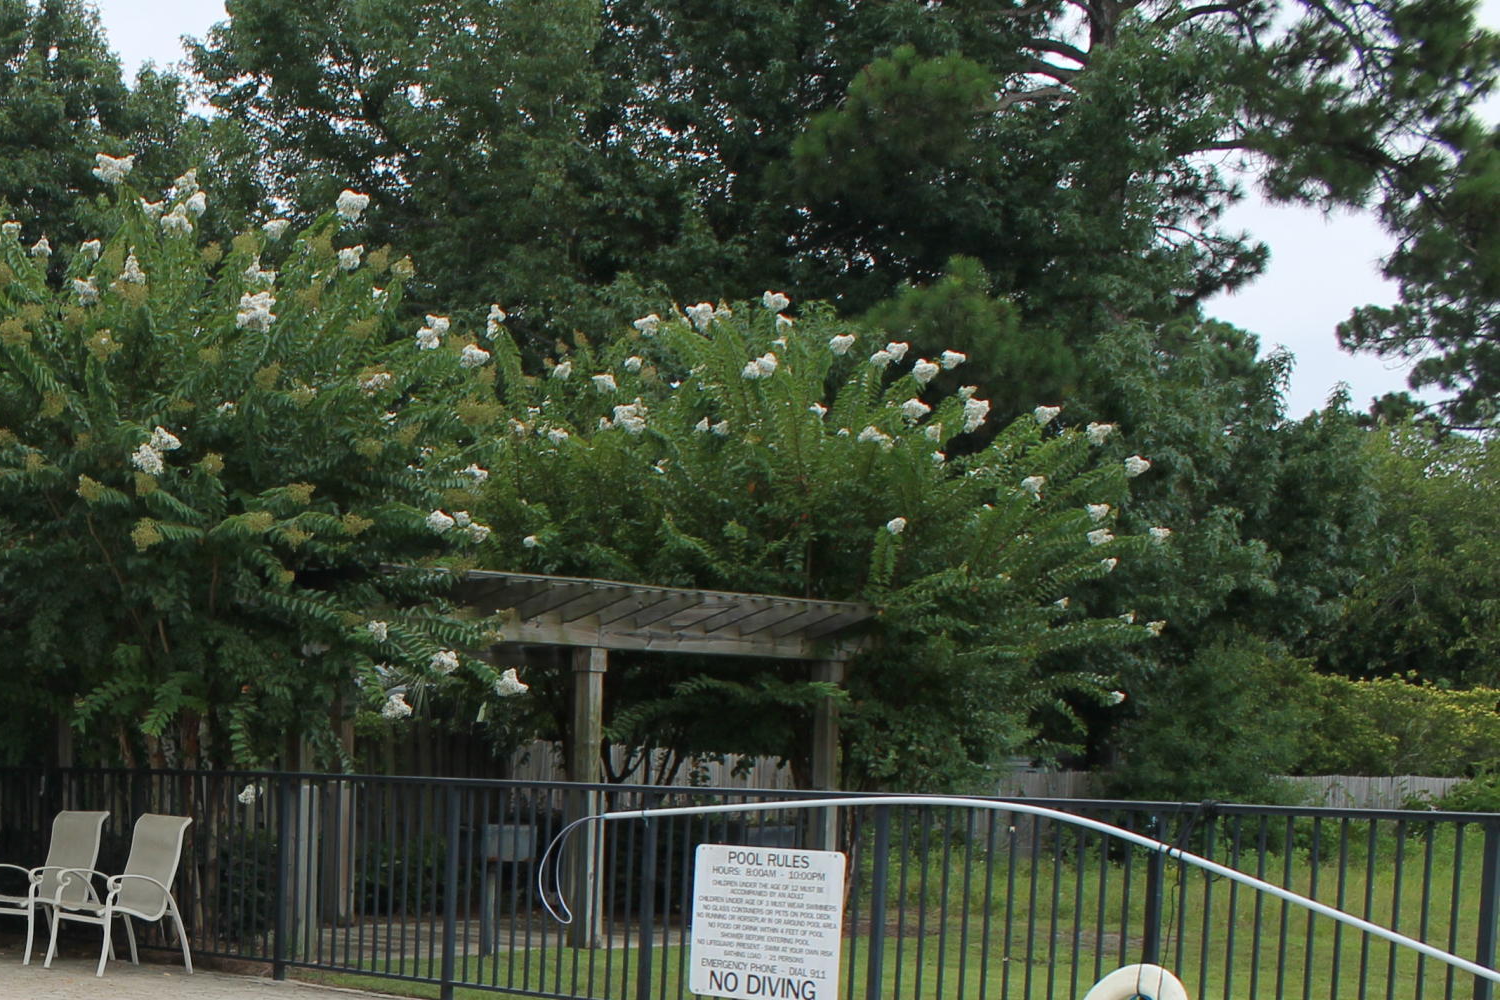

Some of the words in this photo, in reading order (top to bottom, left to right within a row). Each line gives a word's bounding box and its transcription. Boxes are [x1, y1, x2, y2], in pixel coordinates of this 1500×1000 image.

[728, 851, 763, 865] POOL
[768, 853, 810, 869] RULES
[712, 866, 740, 876] HOURS:
[745, 868, 776, 878] 8:00AM
[788, 871, 825, 881] 10:00PM
[698, 895, 724, 903] CHILDREN
[731, 906, 764, 914] CONTAINERS
[705, 912, 727, 920] RUNNING
[737, 915, 766, 923] HORSEPLAY
[783, 919, 806, 927] AROUND
[806, 920, 820, 928] POOL
[760, 926, 779, 934] WITHIN
[706, 939, 734, 947] LIFEGUARD
[736, 941, 760, 950] PRESENT
[720, 931, 743, 939] SHOWER
[745, 933, 765, 941] BEFORE
[766, 936, 793, 944] ENTERING
[795, 938, 809, 946] POOL
[723, 950, 746, 958] BATHING
[778, 955, 804, 963] PERSONS
[701, 958, 748, 970] EMERGENCY
[750, 963, 778, 974] PHONE
[789, 967, 807, 977] DIAL
[809, 969, 826, 979] 911
[708, 970, 738, 992] NO
[746, 974, 816, 1000] DIVING
